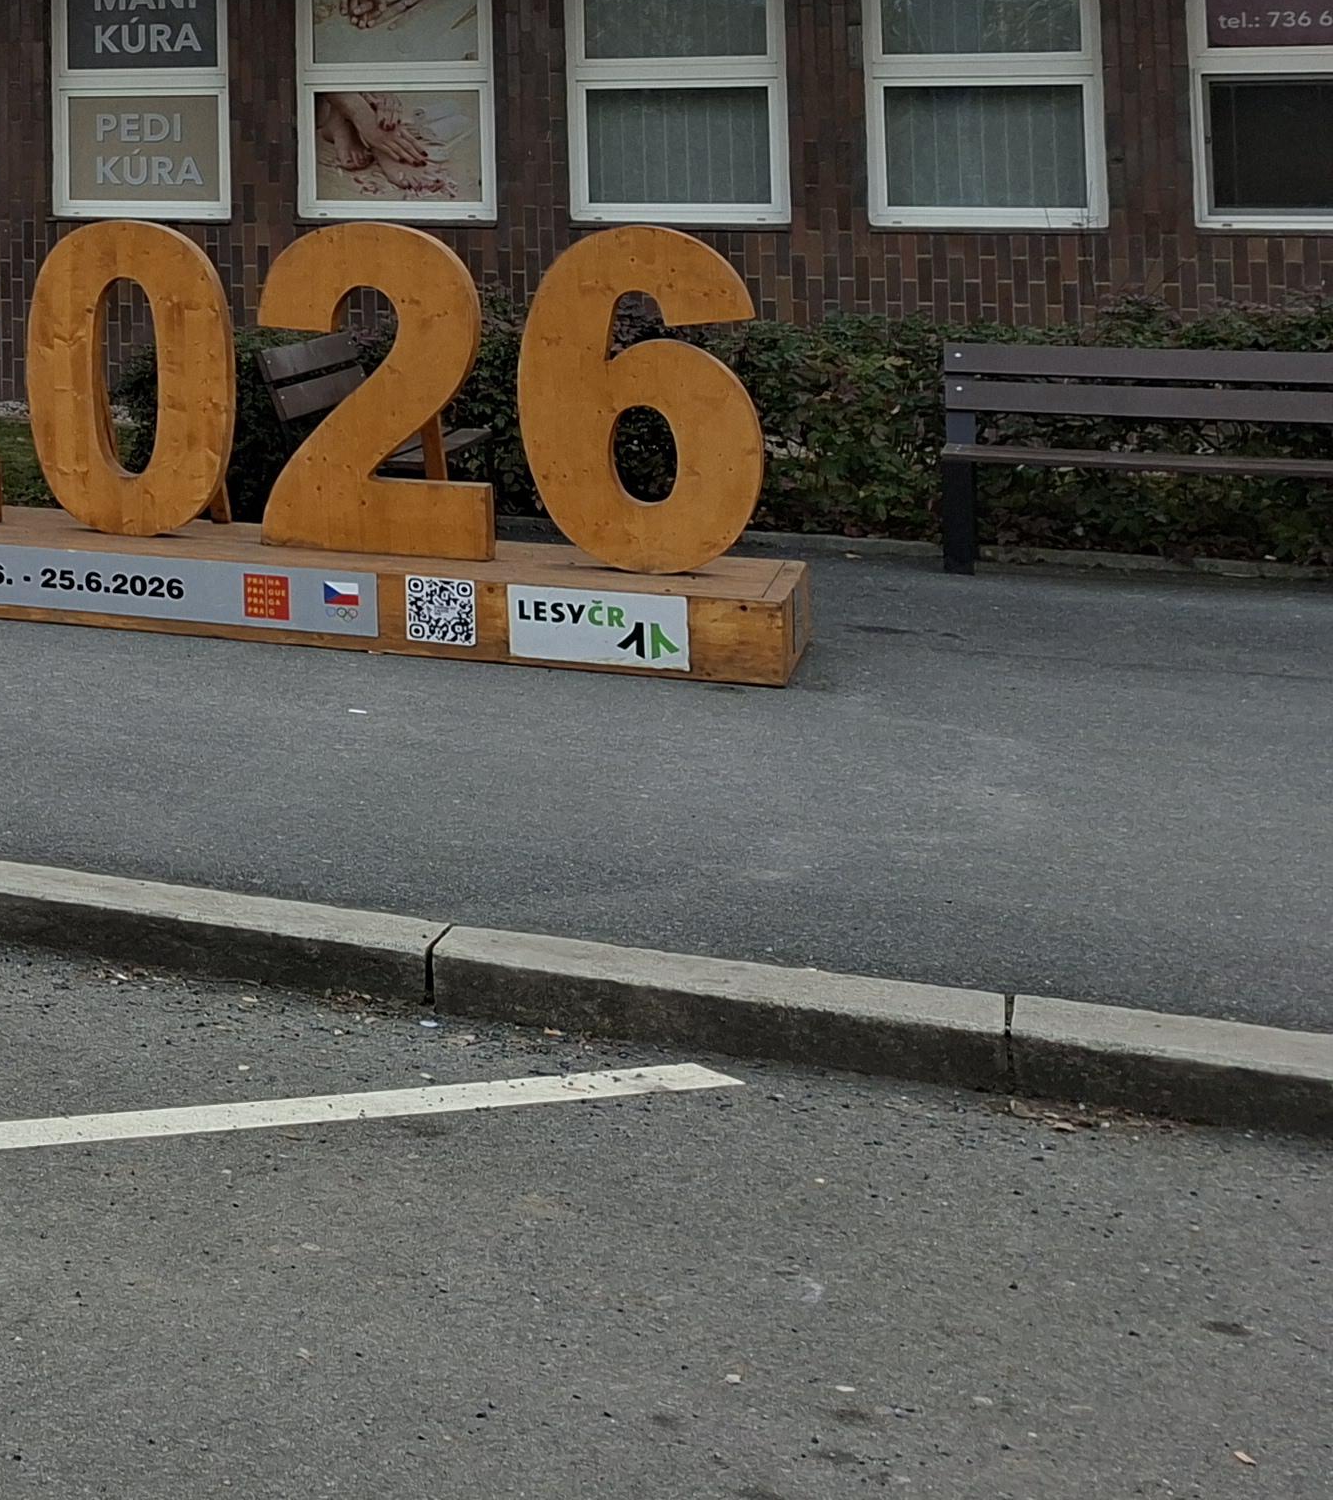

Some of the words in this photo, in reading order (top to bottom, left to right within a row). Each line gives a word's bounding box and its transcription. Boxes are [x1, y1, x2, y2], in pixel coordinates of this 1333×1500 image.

[94, 17, 203, 54] KÚRA
[1217, 11, 1260, 29] tel.:
[1266, 10, 1312, 28] 736
[96, 112, 182, 143] PEDI
[96, 149, 204, 186] KÚRA
[40, 567, 185, 600] 25.6.2026
